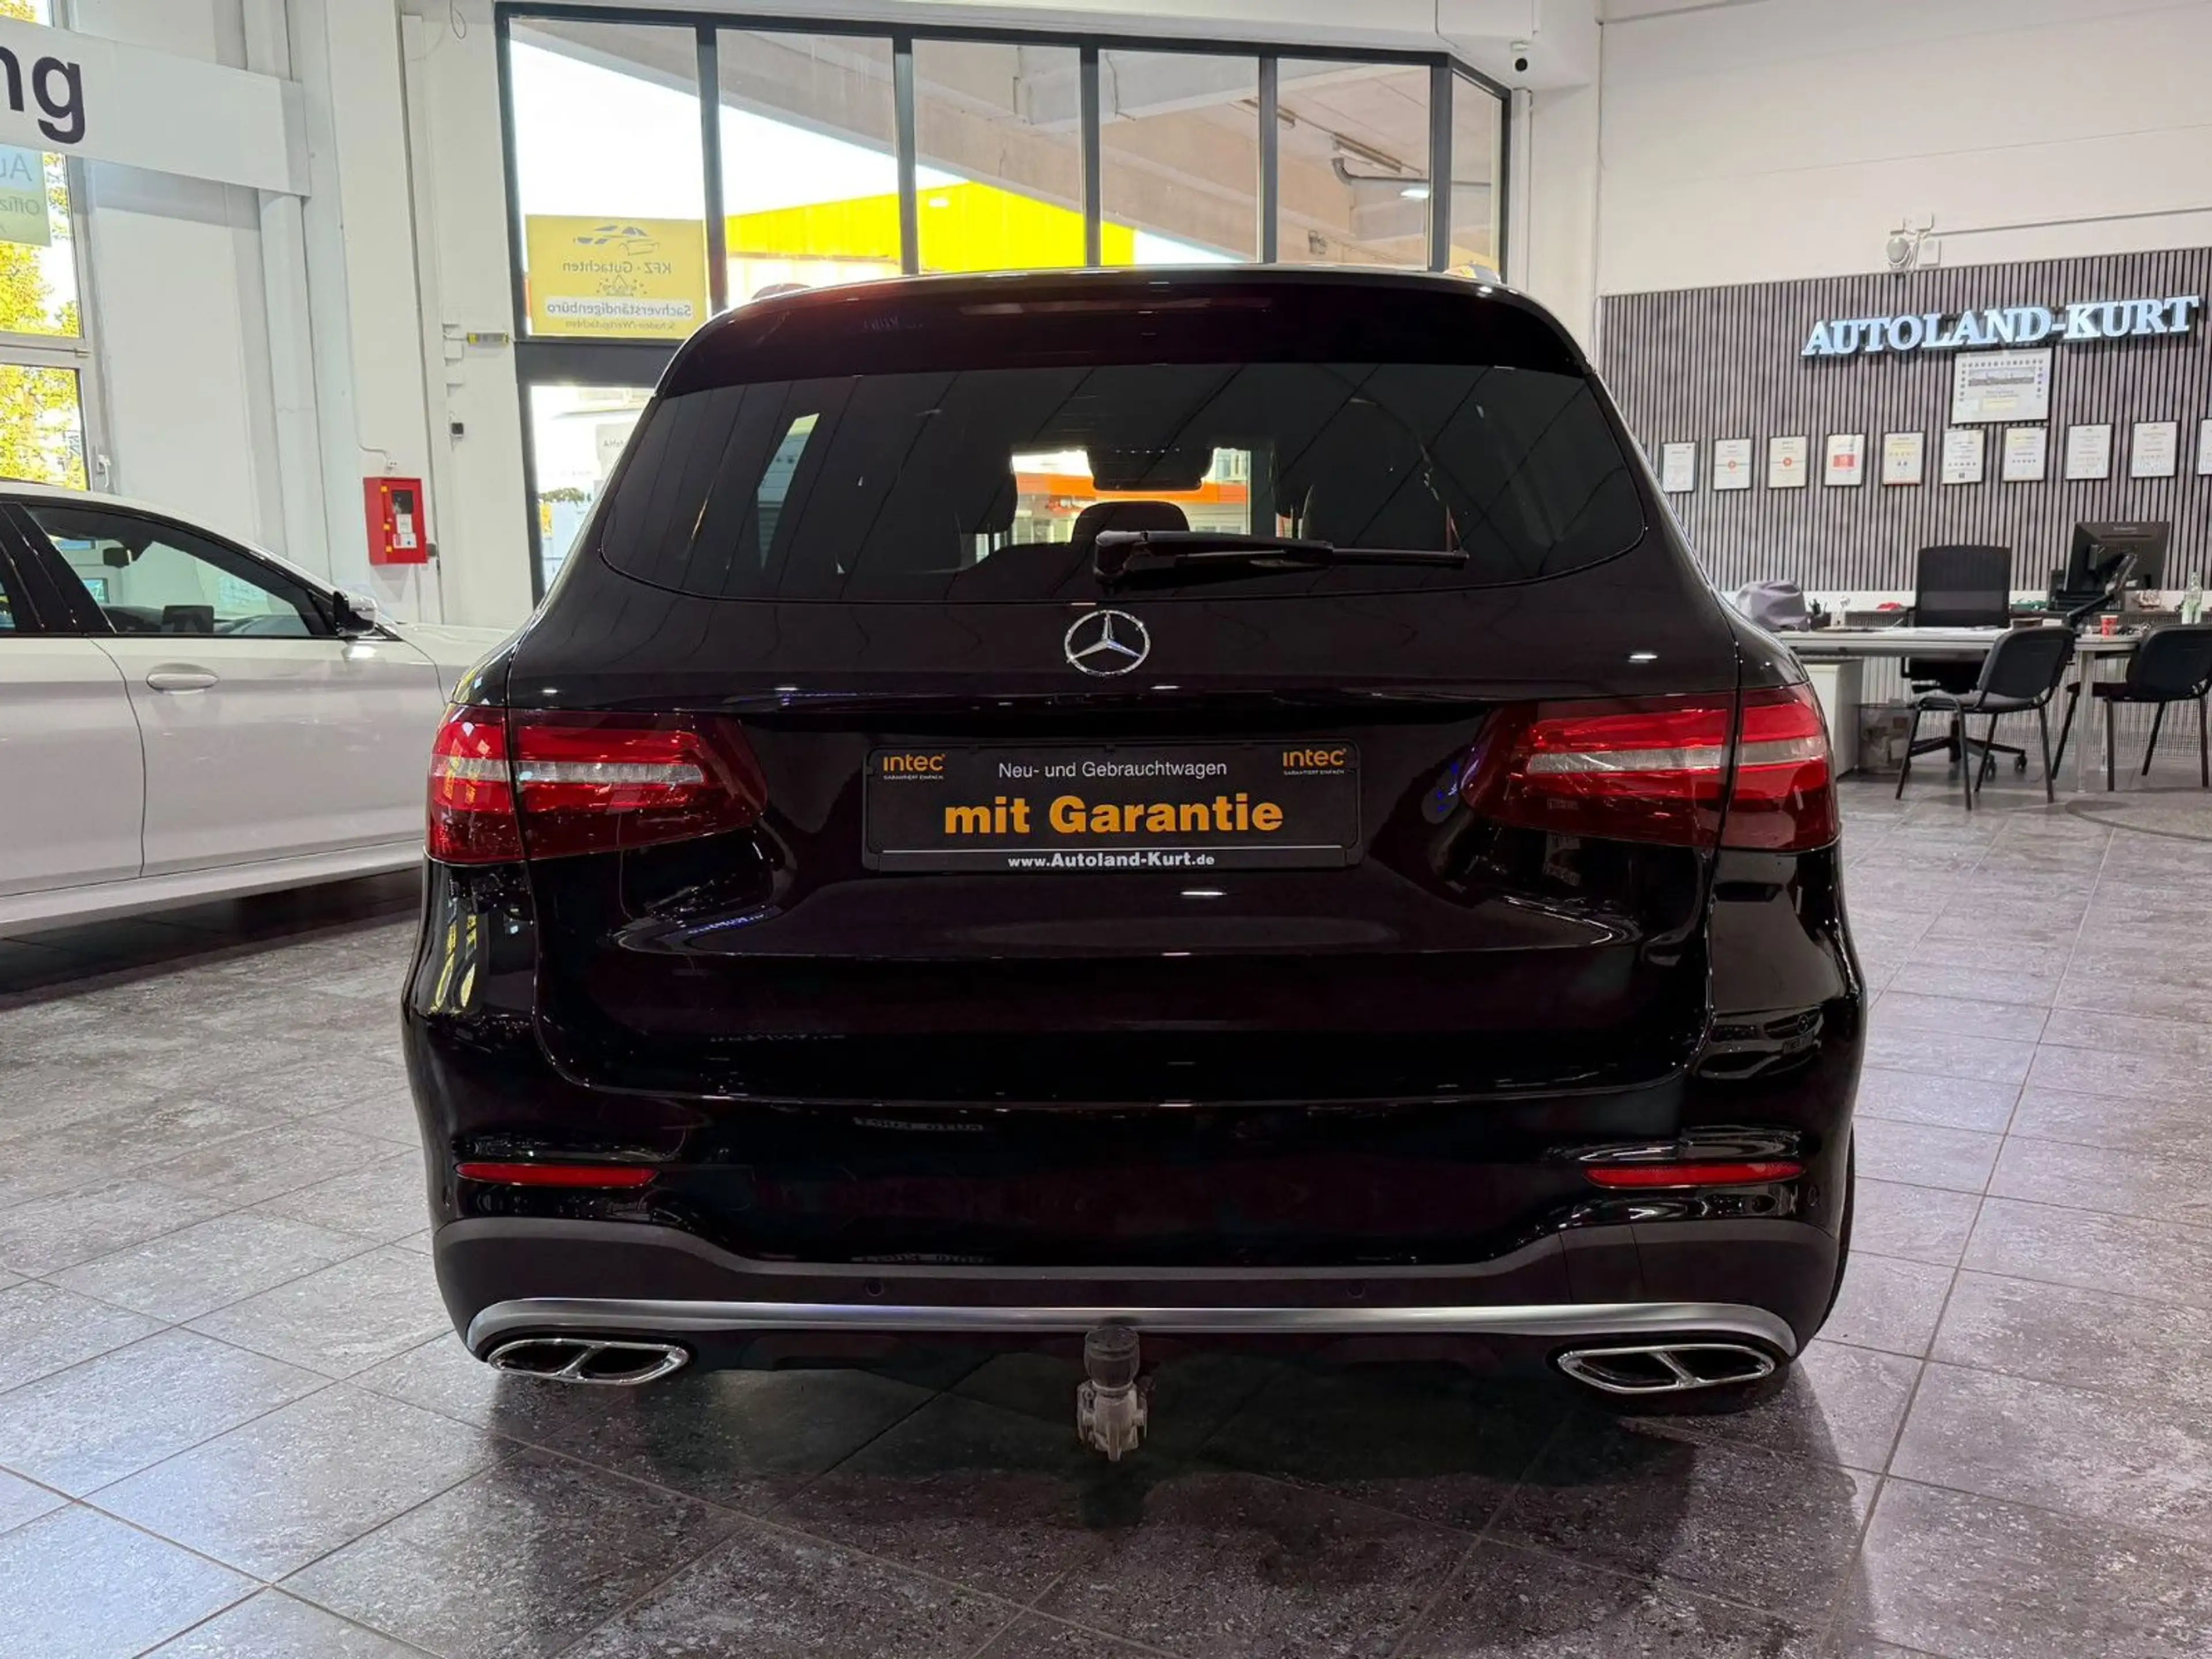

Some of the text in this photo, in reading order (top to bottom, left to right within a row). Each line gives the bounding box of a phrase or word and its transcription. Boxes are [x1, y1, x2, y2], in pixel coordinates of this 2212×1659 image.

[0, 46, 85, 144] ng
[1801, 296, 2199, 355] AUTOLAND-KURT
[883, 754, 944, 771] intec
[1283, 749, 1345, 767] intec
[999, 761, 1228, 779] Neu- und Gebrauchtwagen
[945, 793, 1283, 833] mit Garantie
[1007, 852, 1215, 867] www.Autoland-Kurt.de
